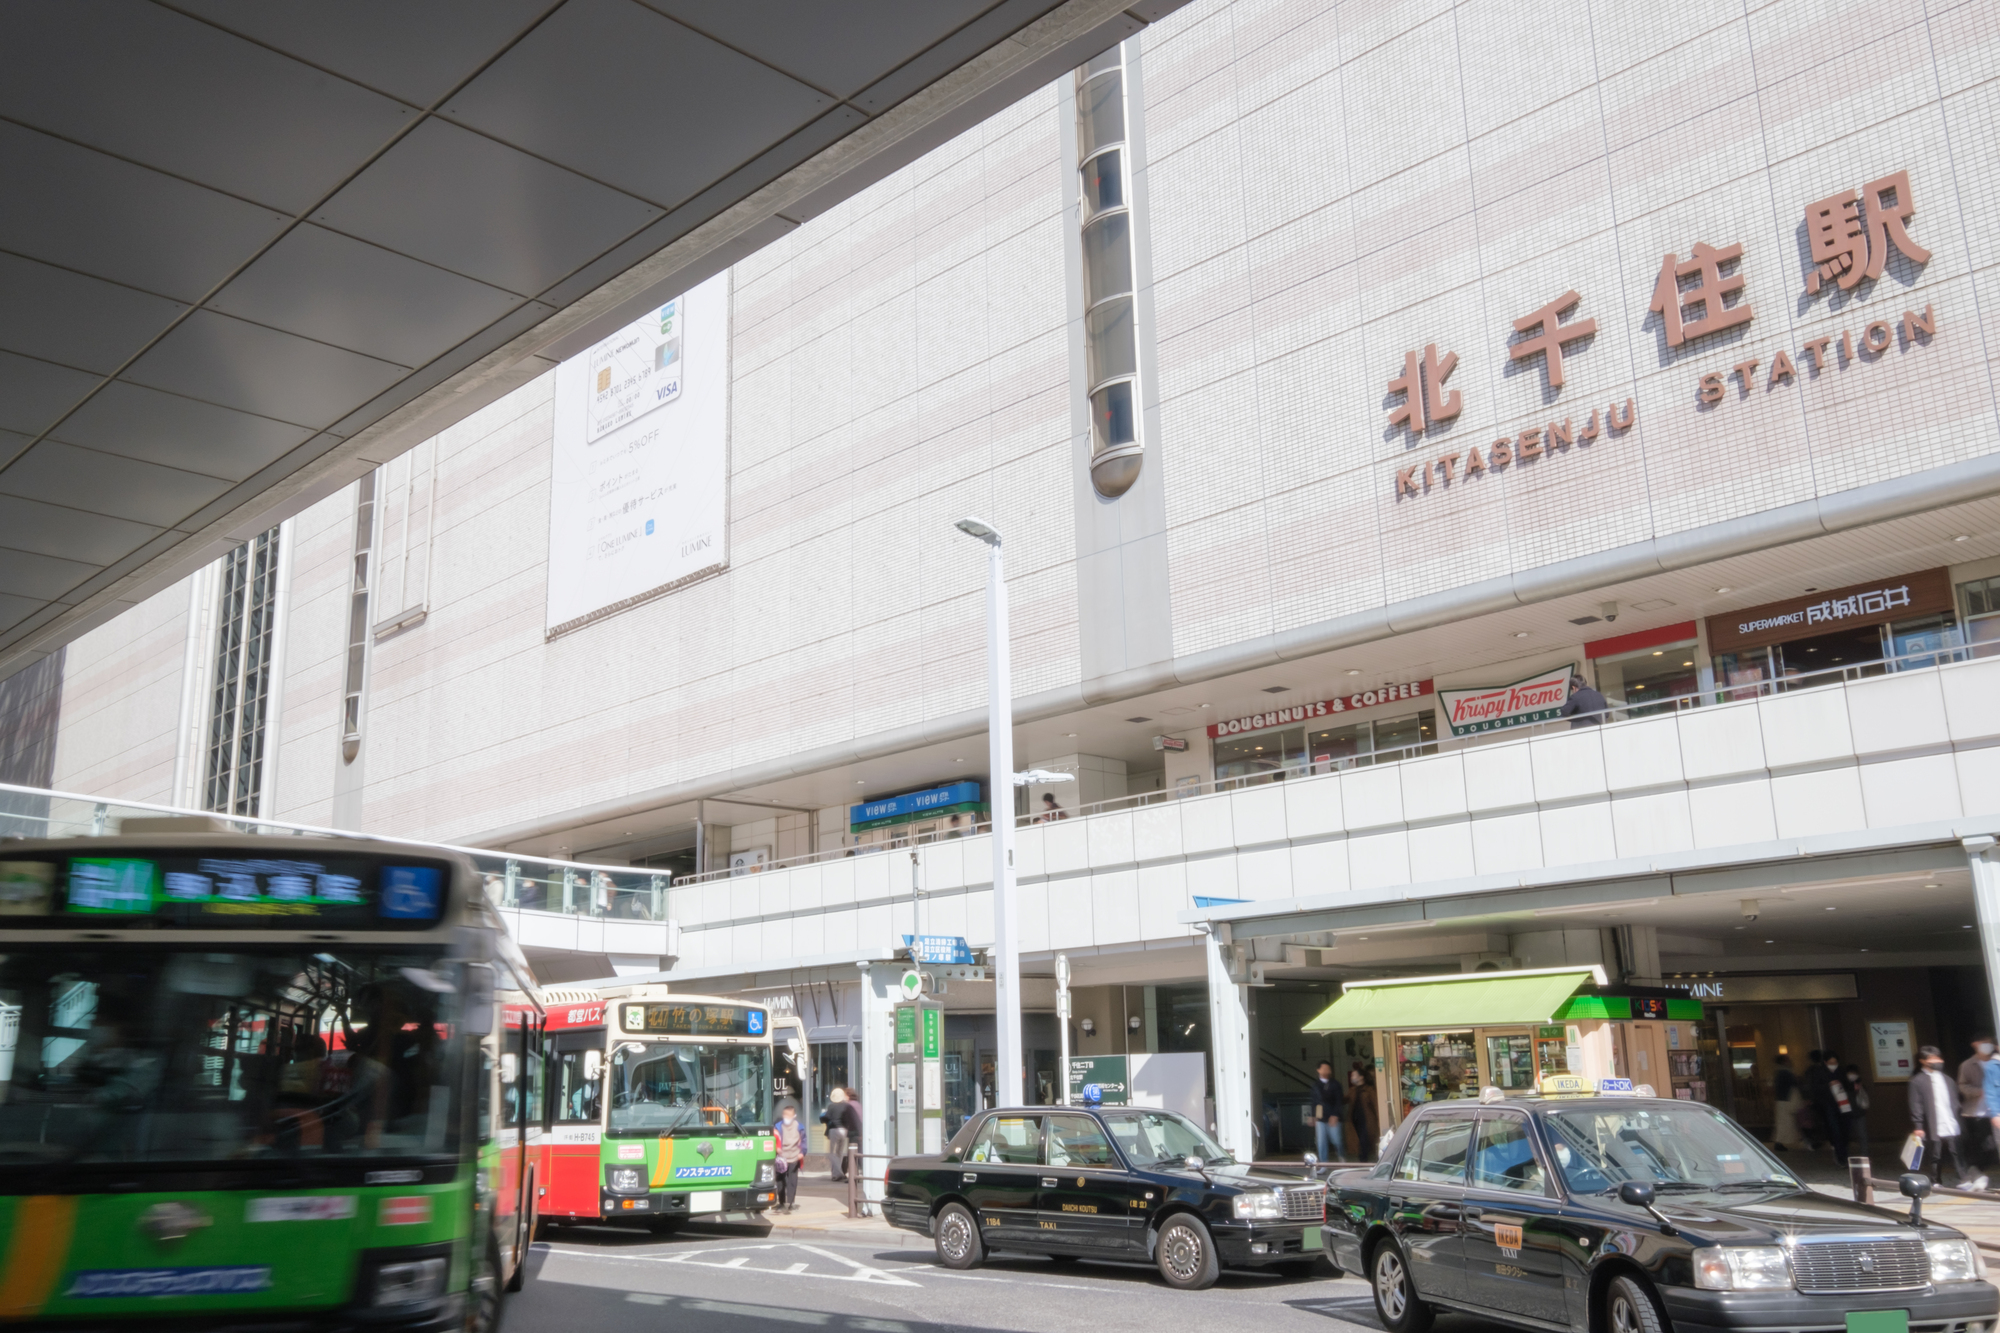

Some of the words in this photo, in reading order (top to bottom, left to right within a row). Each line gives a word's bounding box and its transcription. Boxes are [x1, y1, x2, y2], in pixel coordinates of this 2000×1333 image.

[1388, 170, 1932, 432] 北千住駅
[657, 381, 678, 400] VISA
[1396, 398, 1635, 495] KITASENJU
[1697, 304, 1937, 404] STATION
[628, 428, 660, 454] 5%OFF
[681, 534, 713, 558] LUMINE
[1738, 611, 1804, 634] SUPERMARKET
[1806, 585, 1911, 625] 成城石井
[1217, 701, 1327, 736] DOUGHNUTS
[1332, 697, 1346, 713] &
[1351, 682, 1421, 708] COFFEE
[1452, 689, 1508, 722] Krispy
[1506, 678, 1565, 712] Kreme
[1458, 708, 1562, 735] DOUGHNUTS
[1634, 999, 1663, 1012] KIOSK
[568, 1007, 601, 1024] 都営バス
[672, 1006, 734, 1025] 竹の塚駅
[1557, 1079, 1580, 1089] IKEDA
[1603, 1080, 1632, 1090] カードOK
[574, 1132, 595, 1142] H-B745
[676, 1167, 732, 1178] ノンステップバス
[1062, 1203, 1079, 1212] DAIICHI
[1079, 1204, 1098, 1214] KOUTSU
[985, 1217, 1001, 1227] 1184
[1039, 1221, 1057, 1230] TAXI
[1498, 1228, 1519, 1246] IKEDA
[1501, 1247, 1518, 1259] TAXI
